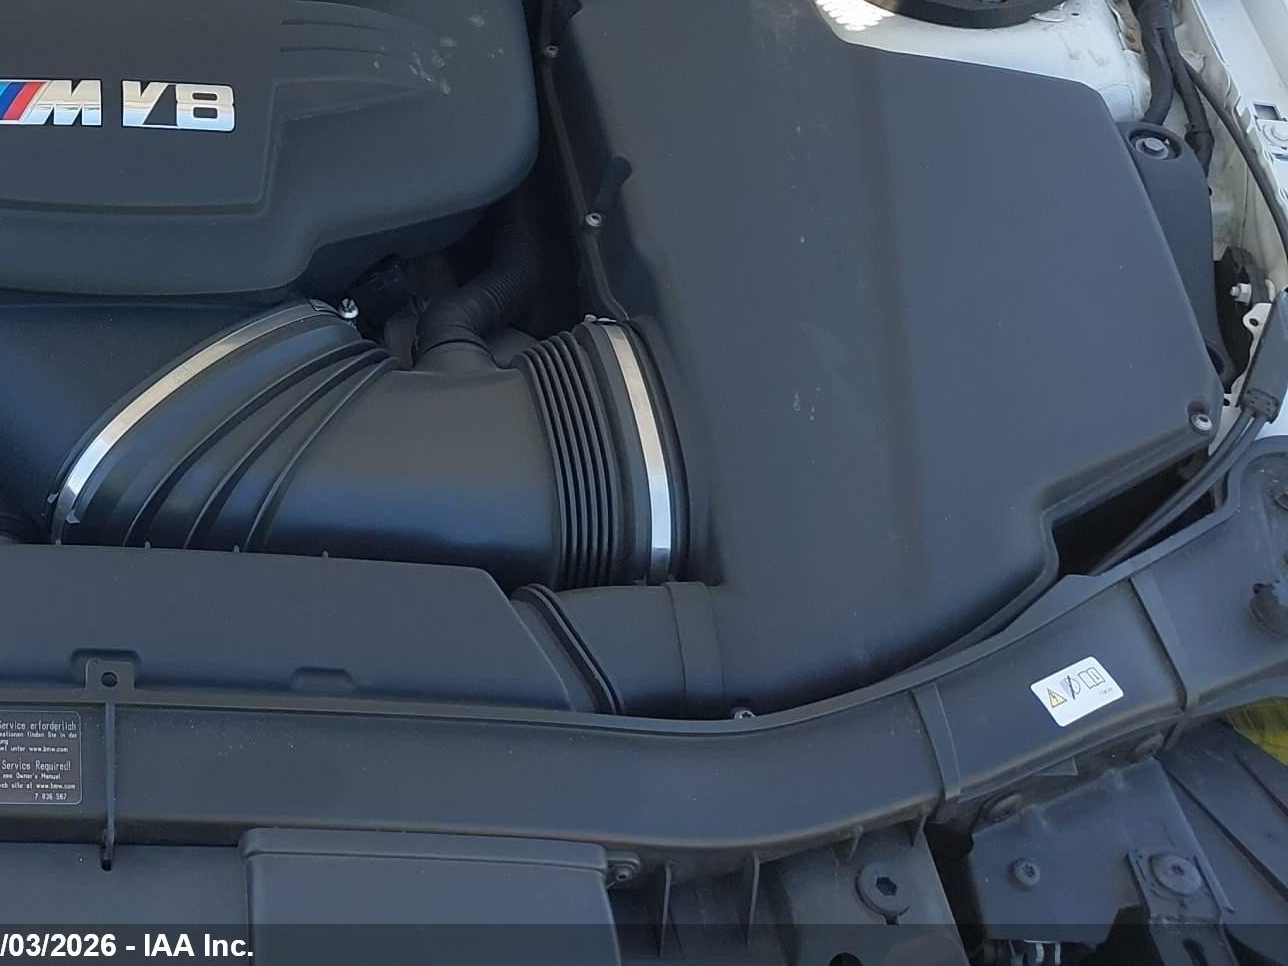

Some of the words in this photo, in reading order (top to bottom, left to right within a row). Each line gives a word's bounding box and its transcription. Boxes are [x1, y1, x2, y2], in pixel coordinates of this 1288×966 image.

[122, 80, 235, 132] V8
[31, 720, 76, 731] erforderlich
[2, 760, 30, 770] Service
[36, 760, 71, 771] Required!
